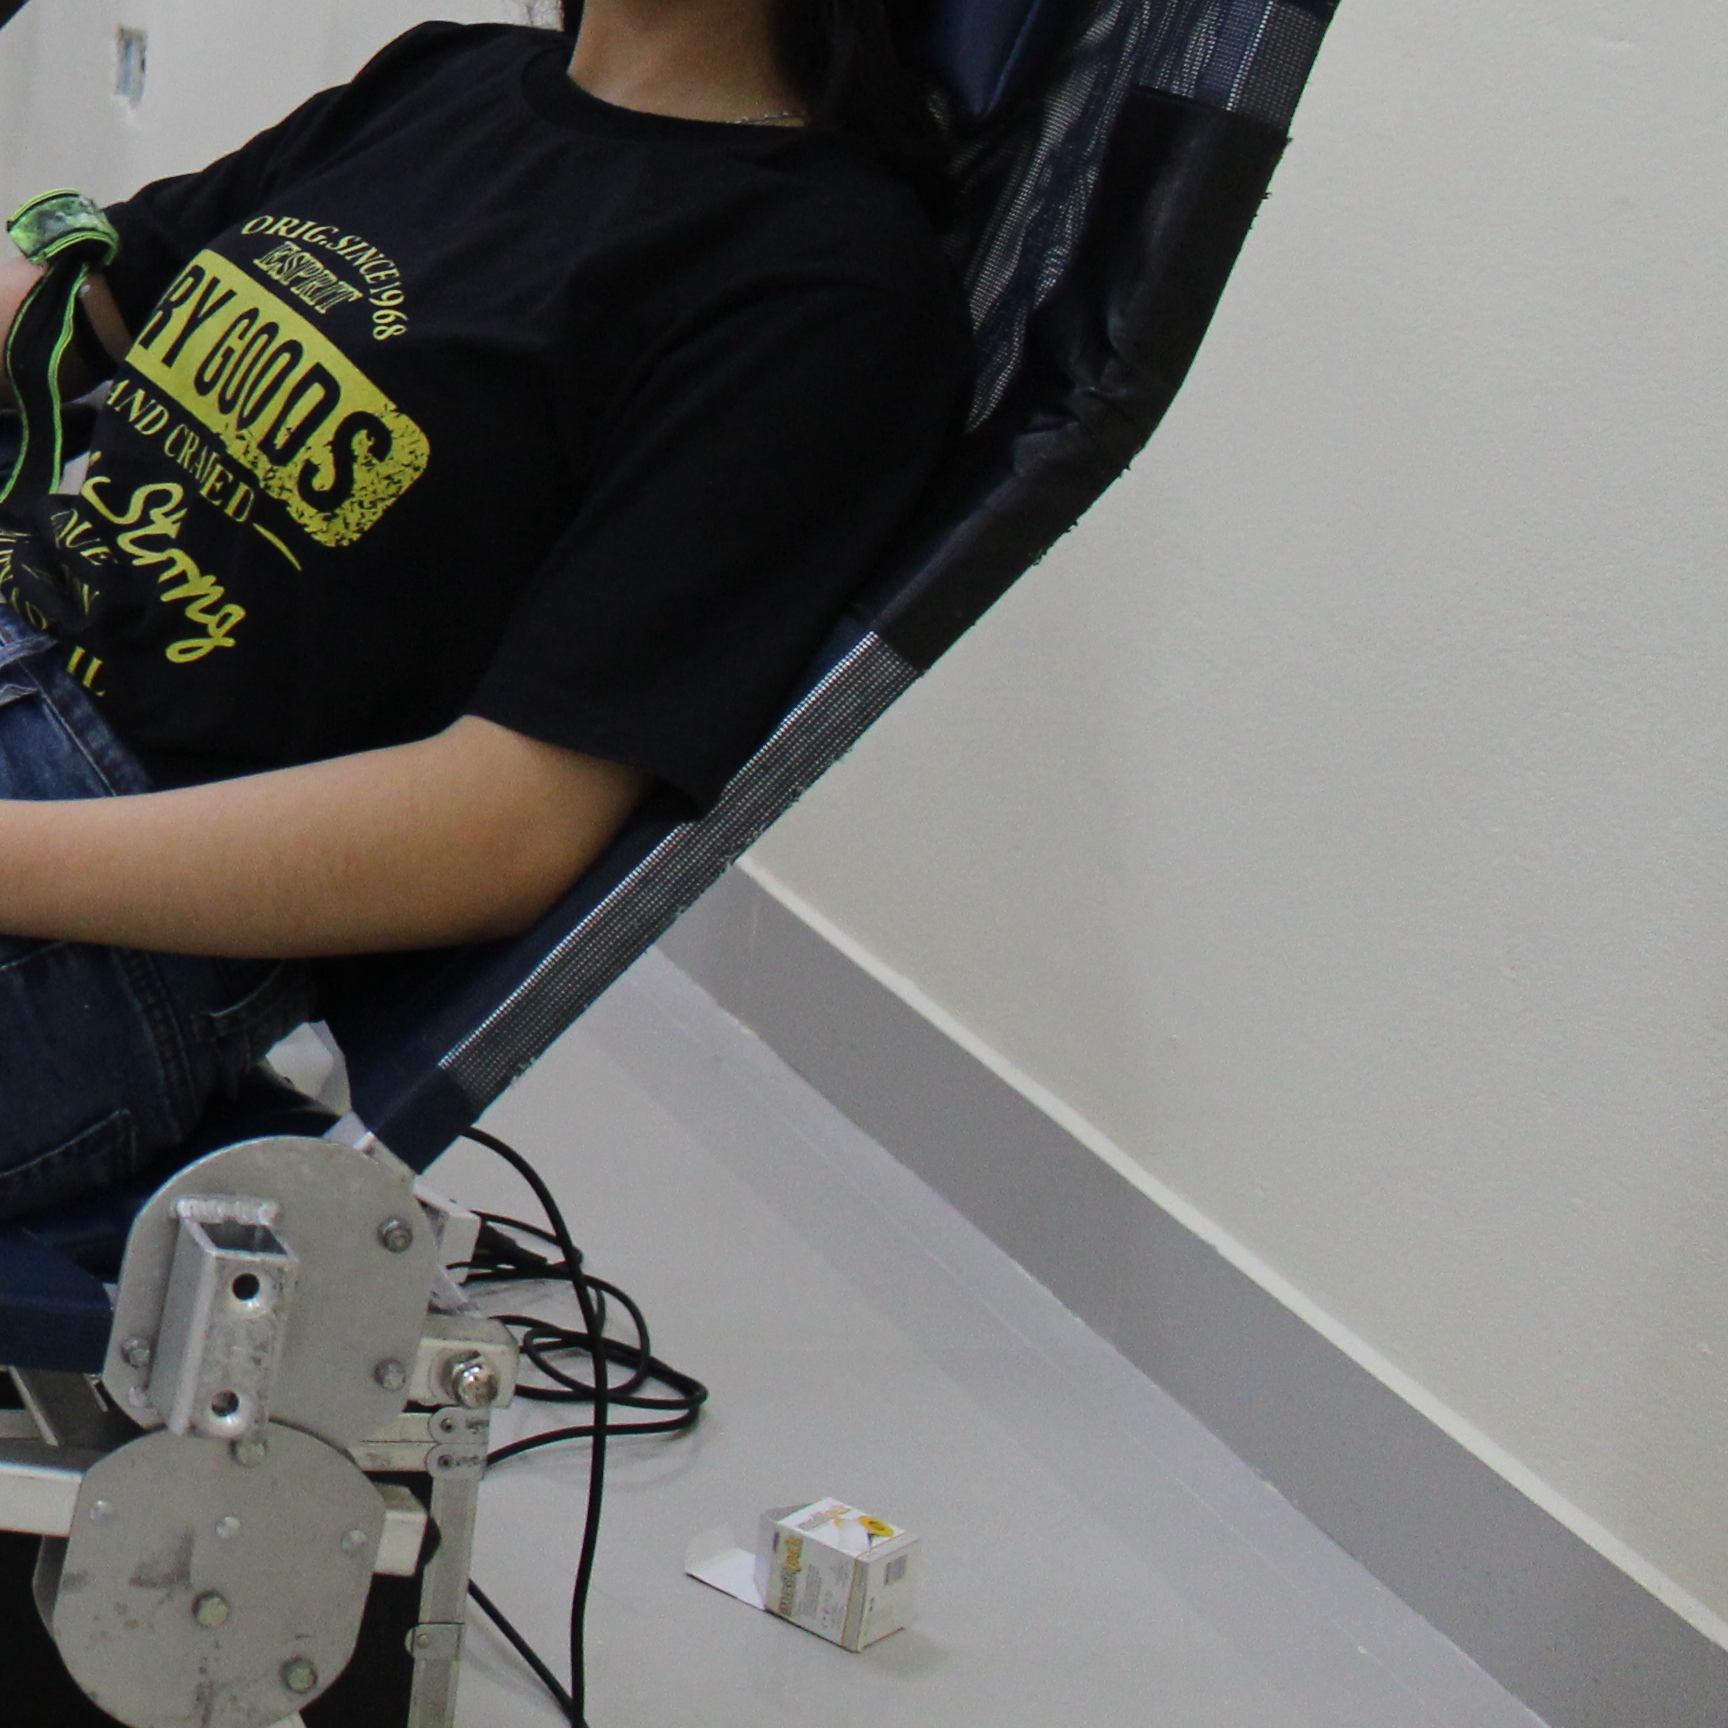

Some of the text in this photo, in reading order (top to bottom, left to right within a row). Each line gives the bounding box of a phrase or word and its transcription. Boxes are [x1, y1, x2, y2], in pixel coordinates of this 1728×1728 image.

[253, 241, 363, 314] ESPRIT
[368, 281, 409, 341] 1968
[194, 307, 393, 513] GOODS
